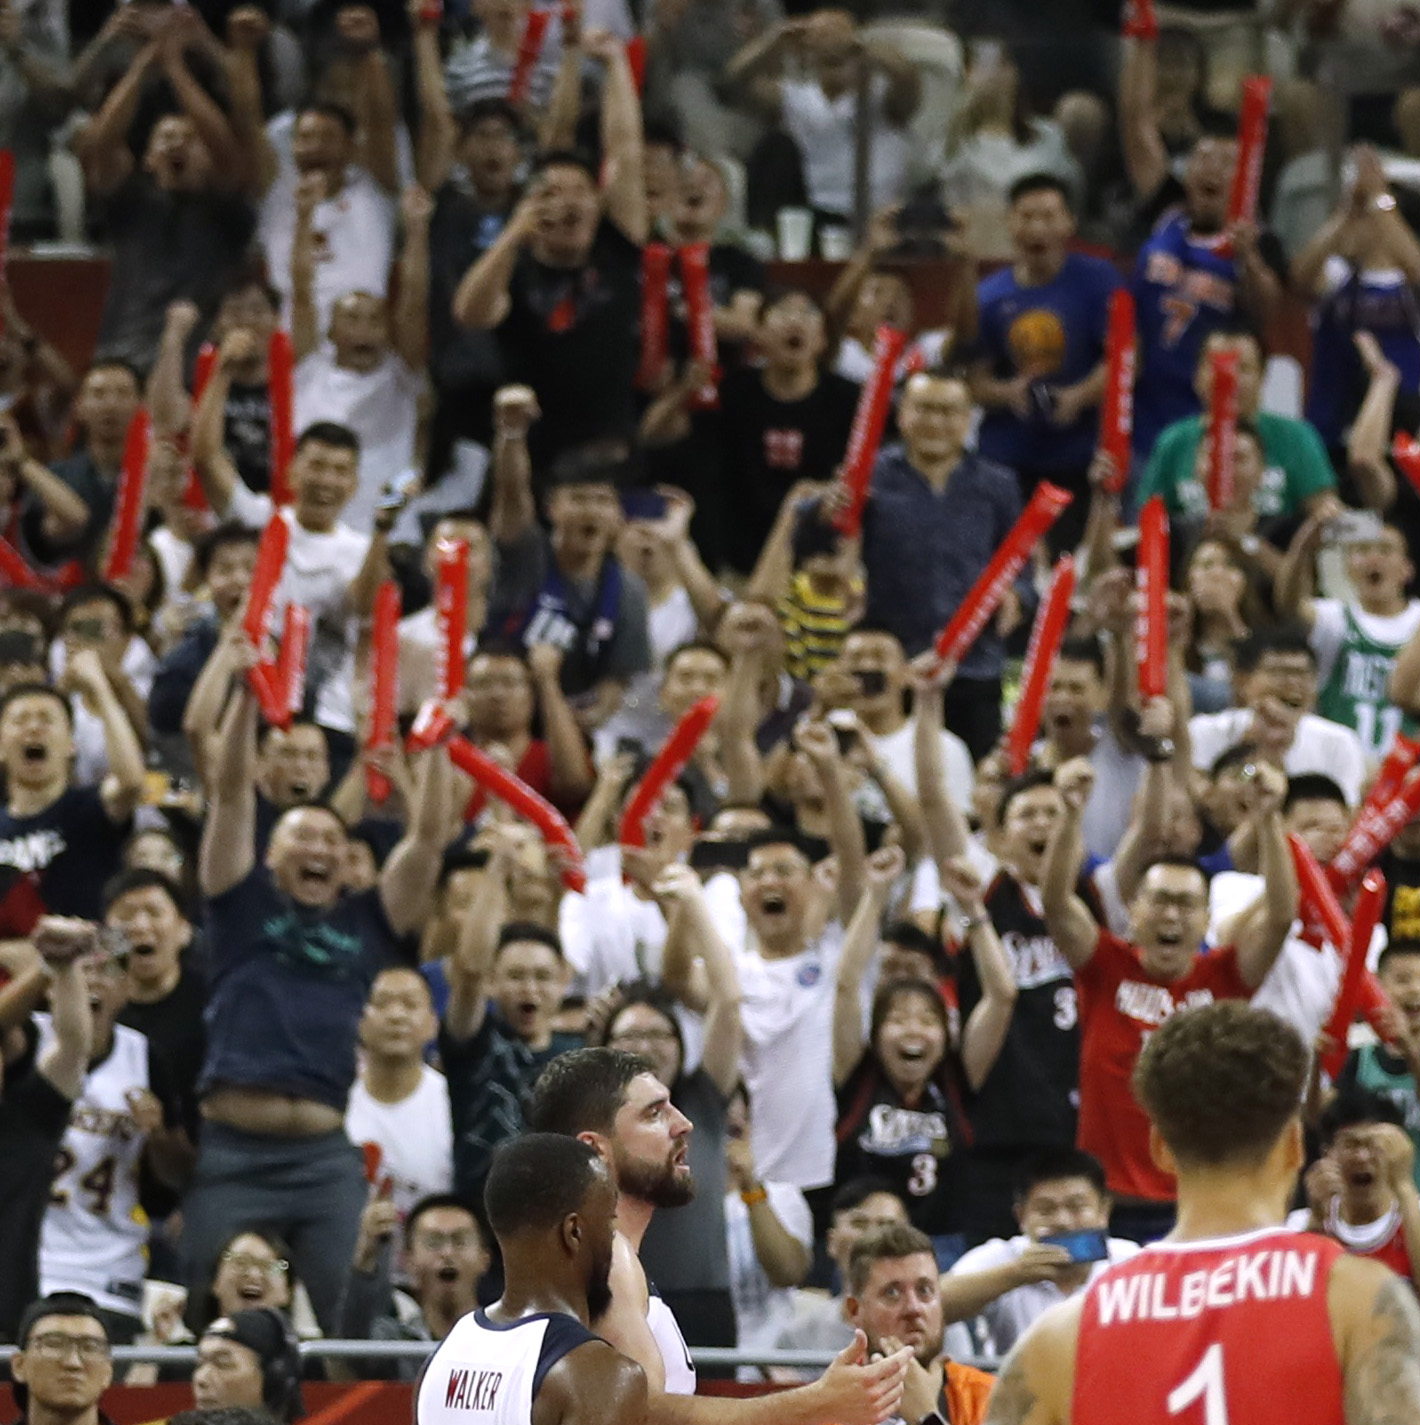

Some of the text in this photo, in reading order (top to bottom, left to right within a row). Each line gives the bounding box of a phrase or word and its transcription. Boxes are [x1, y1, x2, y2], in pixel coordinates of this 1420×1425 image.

[1053, 986, 1078, 1031] 3
[908, 1153, 937, 1196] 3
[1099, 1250, 1318, 1327] WILBEKIN
[445, 1368, 503, 1411] WALKER
